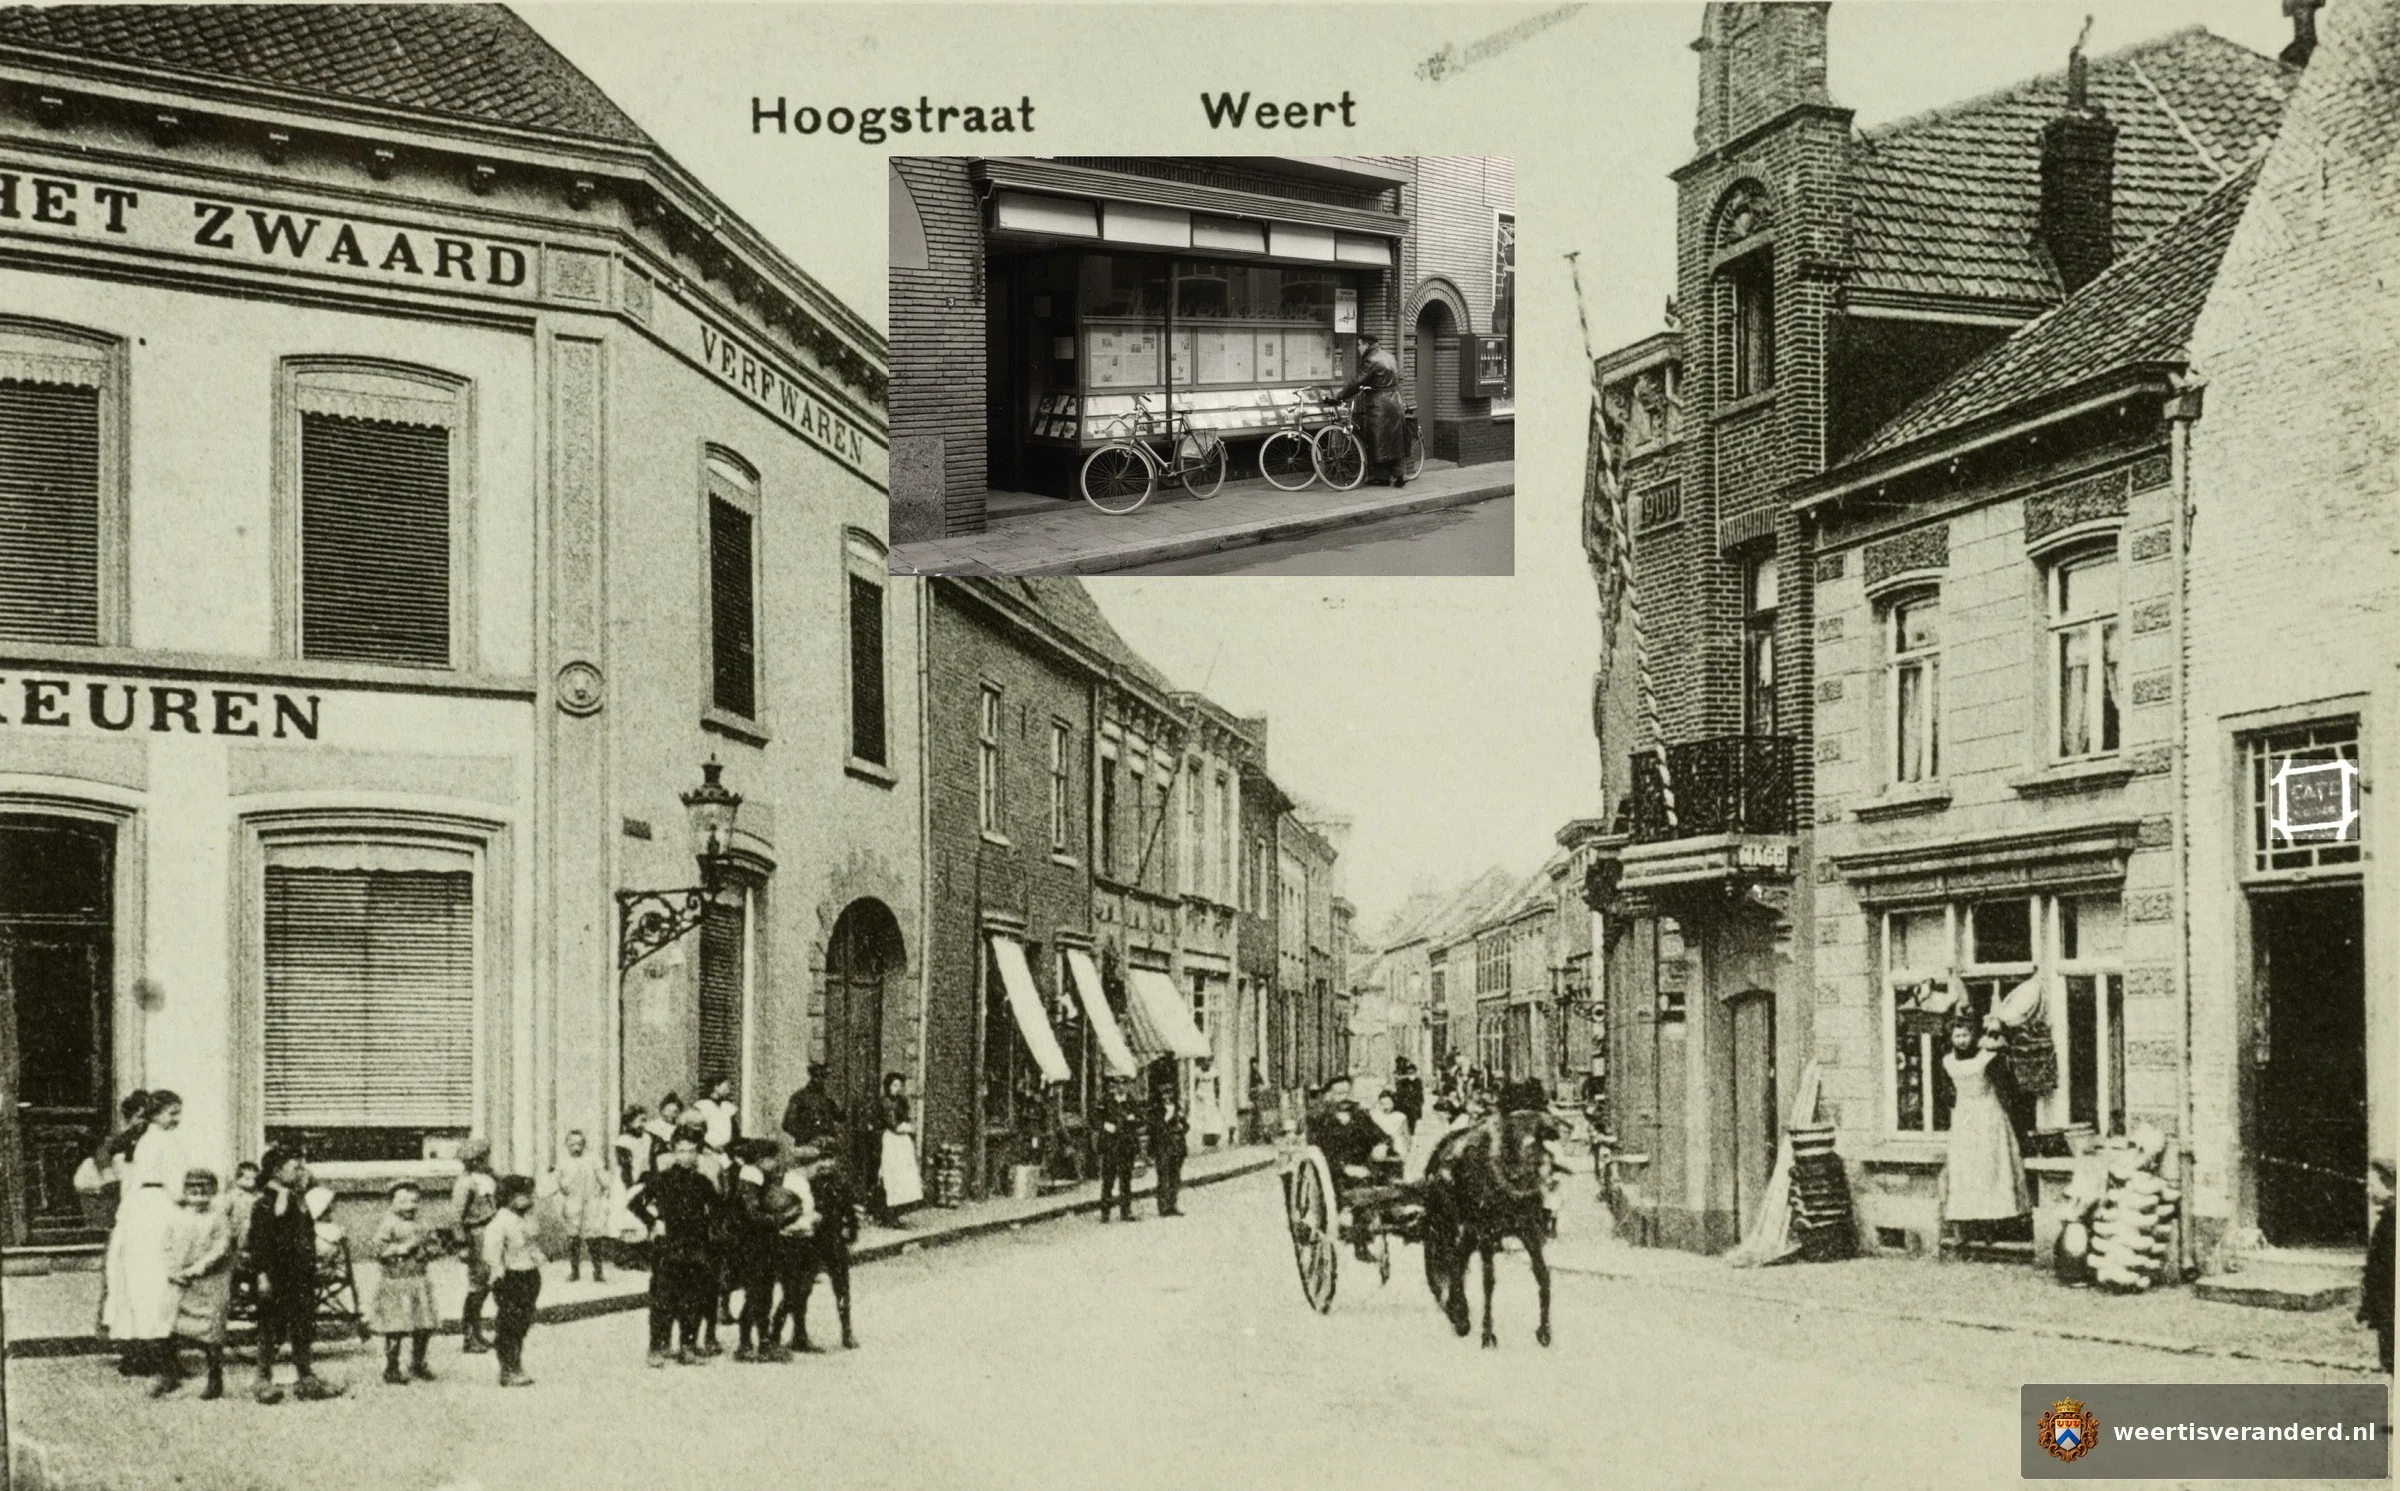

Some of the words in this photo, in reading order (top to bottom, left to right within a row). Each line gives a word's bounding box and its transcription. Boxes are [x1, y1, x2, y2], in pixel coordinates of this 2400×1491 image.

[194, 201, 527, 288] ZWAARD
[700, 324, 863, 466] VERFWAREN
[0, 676, 321, 740] EUREN
